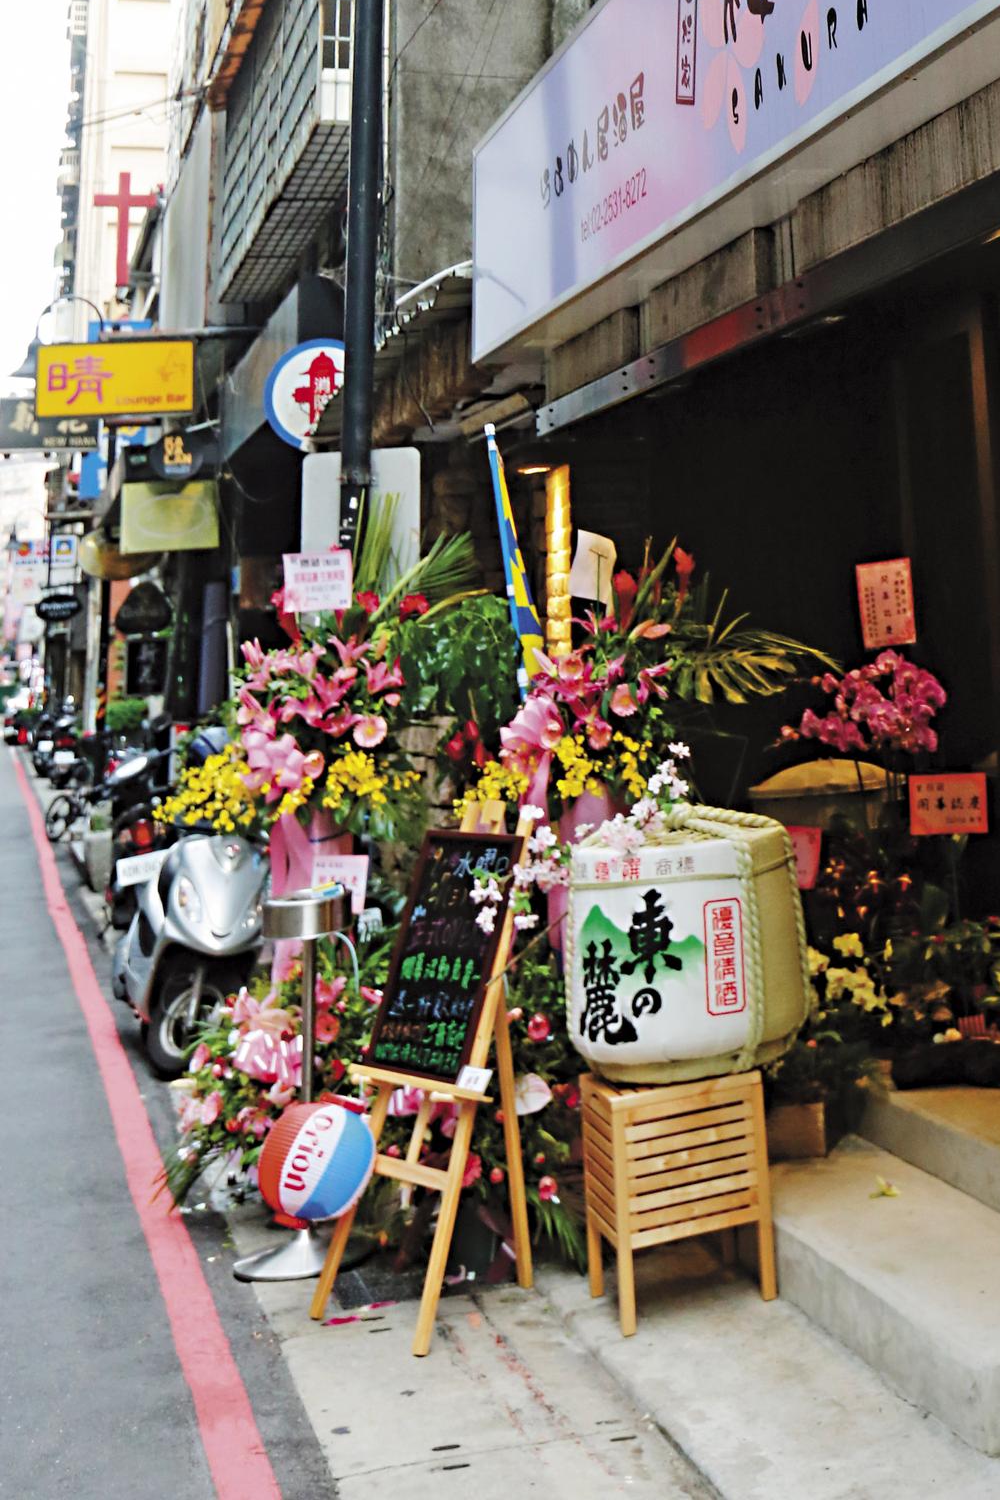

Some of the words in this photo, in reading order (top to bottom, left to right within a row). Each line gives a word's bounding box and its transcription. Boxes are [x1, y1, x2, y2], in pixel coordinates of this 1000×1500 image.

[47, 355, 114, 405] 晴
[166, 392, 187, 404] Bar
[283, 1113, 335, 1192] Orion
